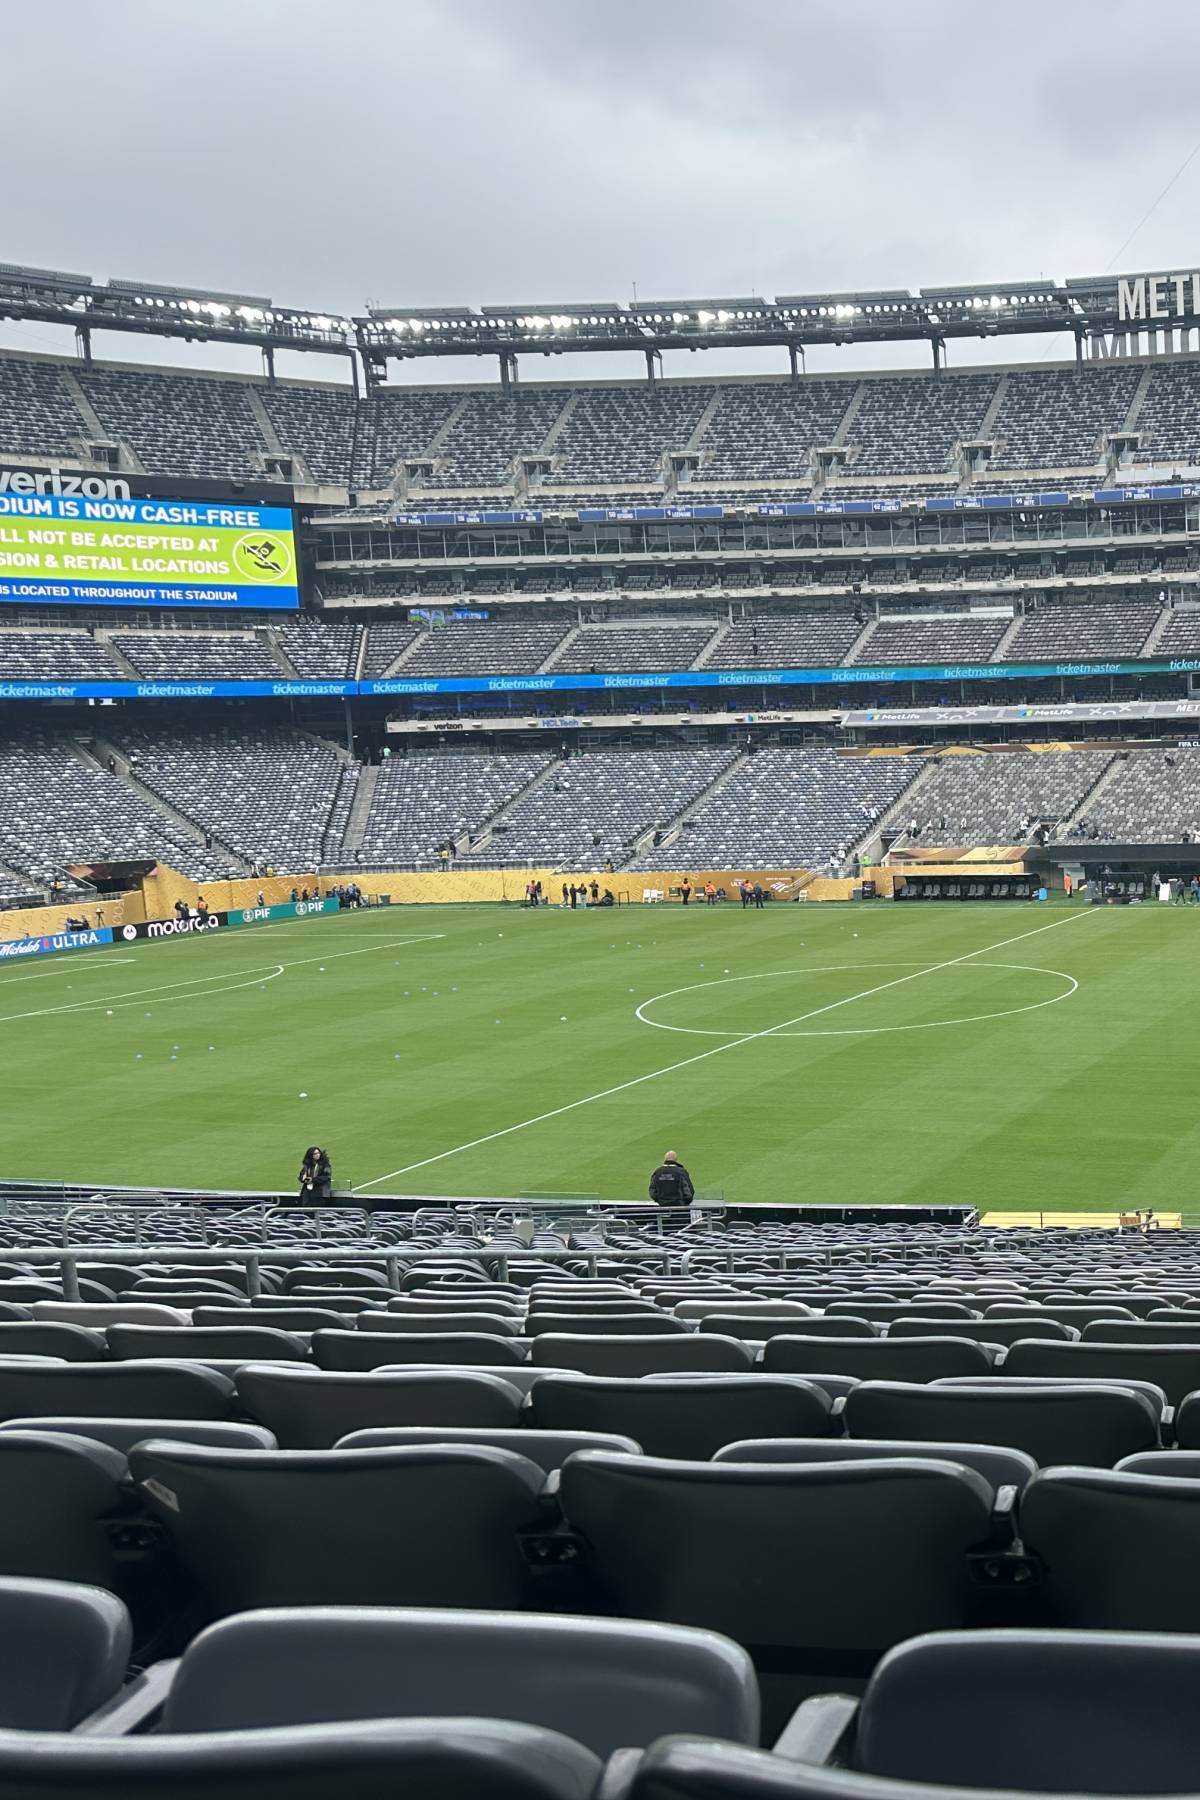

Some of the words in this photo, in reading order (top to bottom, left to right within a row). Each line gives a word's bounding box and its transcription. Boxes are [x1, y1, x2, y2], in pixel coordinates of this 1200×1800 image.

[58, 500, 80, 517] IS
[85, 502, 136, 520] NOW
[141, 505, 261, 527] CASH-FREE
[28, 530, 66, 545] NOT
[71, 532, 97, 547] BE
[100, 533, 194, 551] ACCEPTED
[198, 538, 219, 552] AT
[45, 554, 59, 568] &
[63, 555, 129, 571] RETAIL
[132, 558, 230, 575] LOCATIONS
[13, 584, 70, 597] LOCATED
[72, 586, 156, 599] THROUGHOUT
[159, 589, 184, 600] THE
[185, 590, 238, 601] STADIUM
[944, 667, 1008, 678] ticketmaster
[1056, 663, 1120, 674] ticketmaster
[604, 675, 670, 687] ticketmaster
[719, 673, 783, 684] ticketmaster
[832, 670, 896, 681] ticketmaster
[272, 683, 346, 694] ticketmaster
[373, 681, 439, 692] ticketmaster
[489, 678, 555, 689] ticketmaster
[137, 684, 215, 696] ticketmaster
[434, 722, 463, 730] verizon
[308, 901, 325, 913] PIF
[255, 907, 271, 920] PIF
[53, 931, 98, 949] ULTRA
